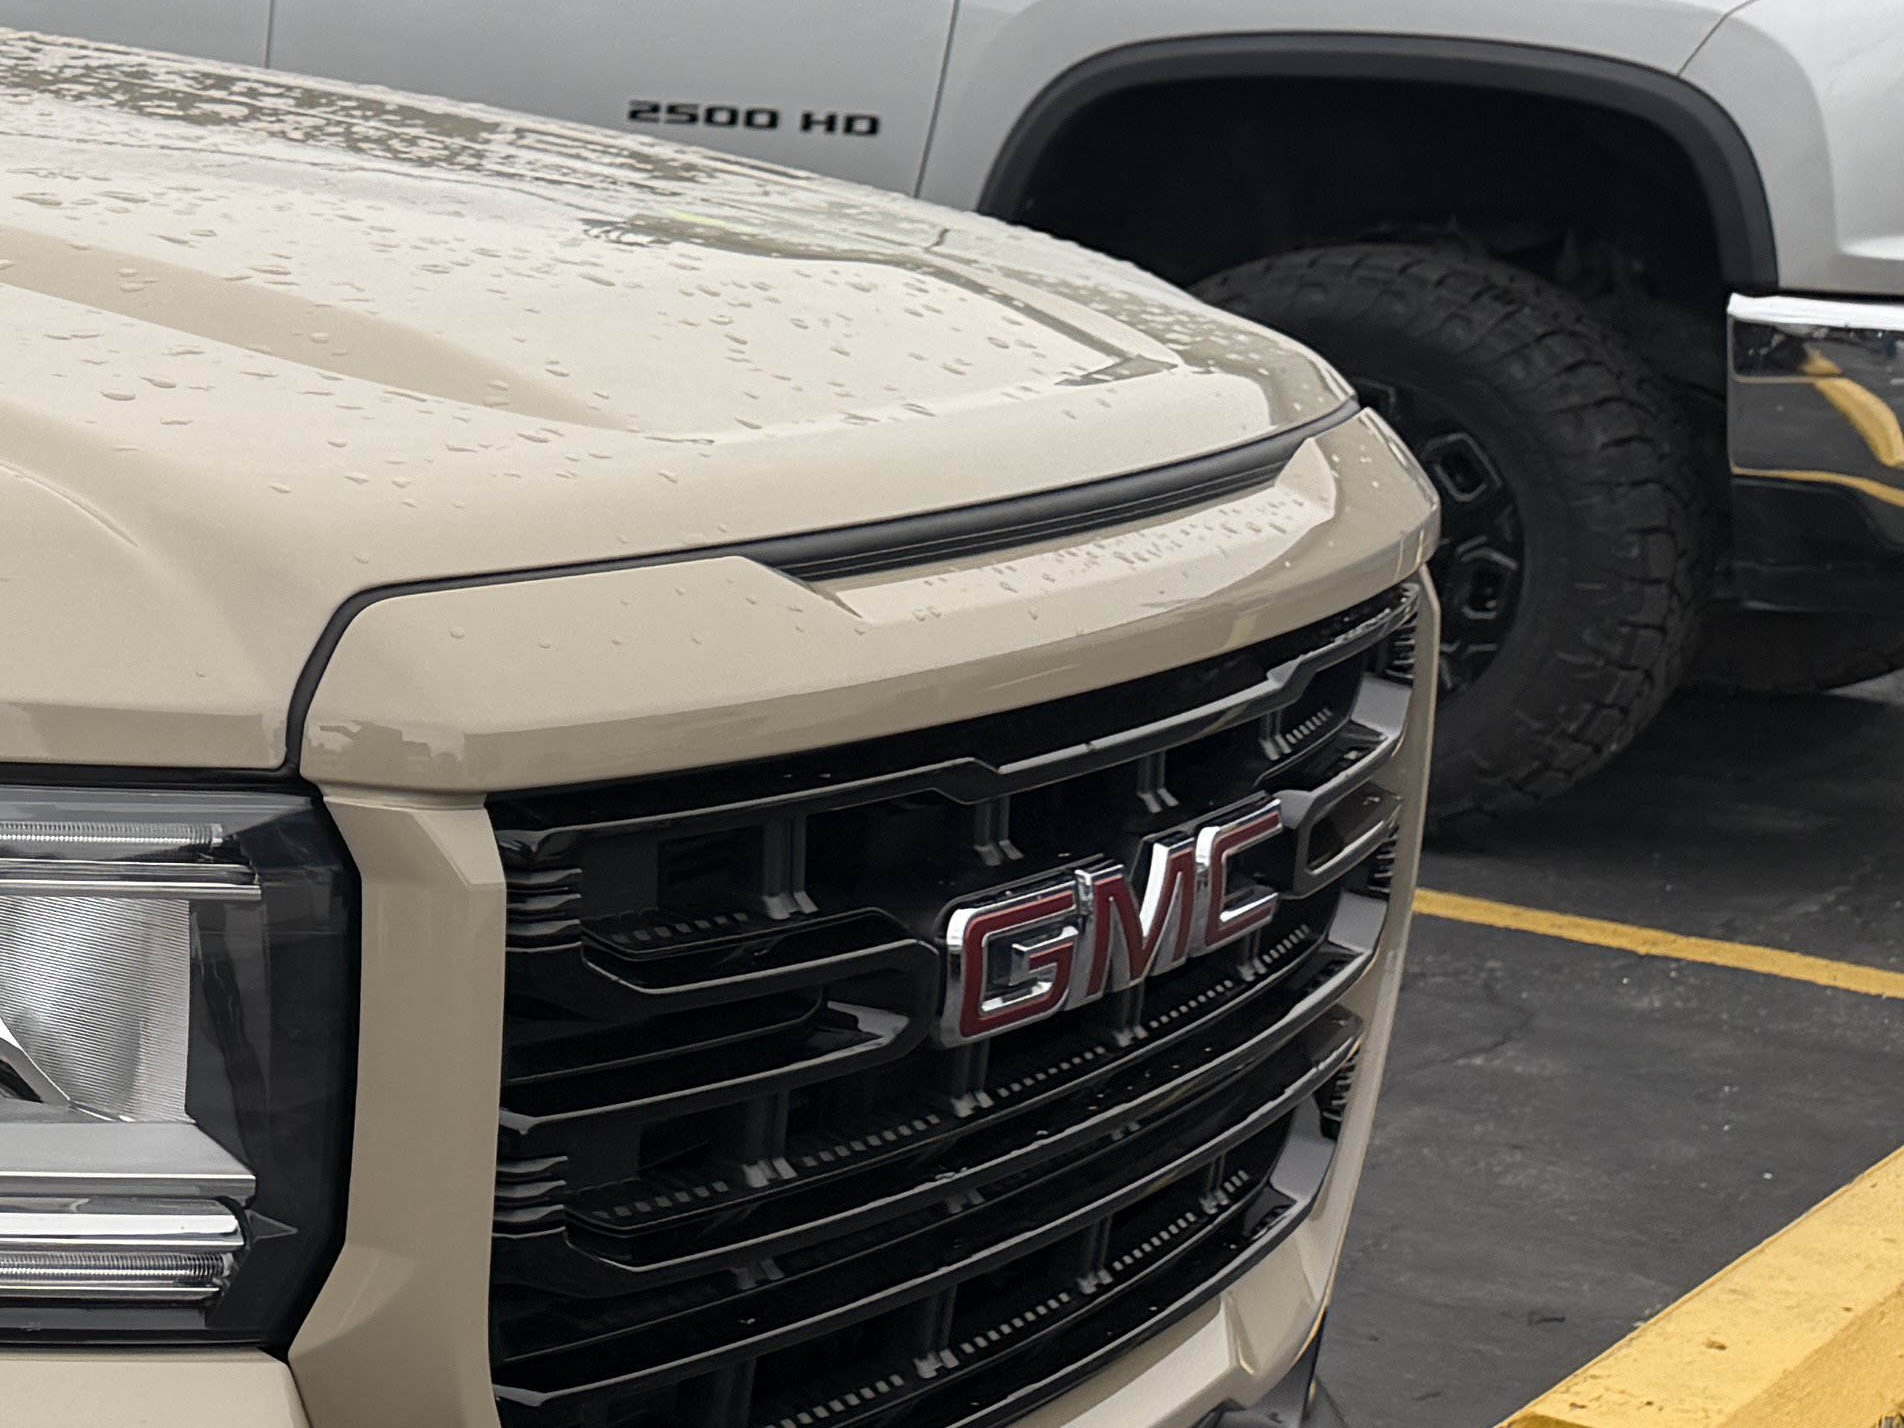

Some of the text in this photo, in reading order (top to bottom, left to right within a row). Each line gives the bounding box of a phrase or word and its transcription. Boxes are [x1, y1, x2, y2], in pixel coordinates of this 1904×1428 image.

[627, 99, 881, 137] 2500 HD
[940, 798, 1284, 1050] GMC
